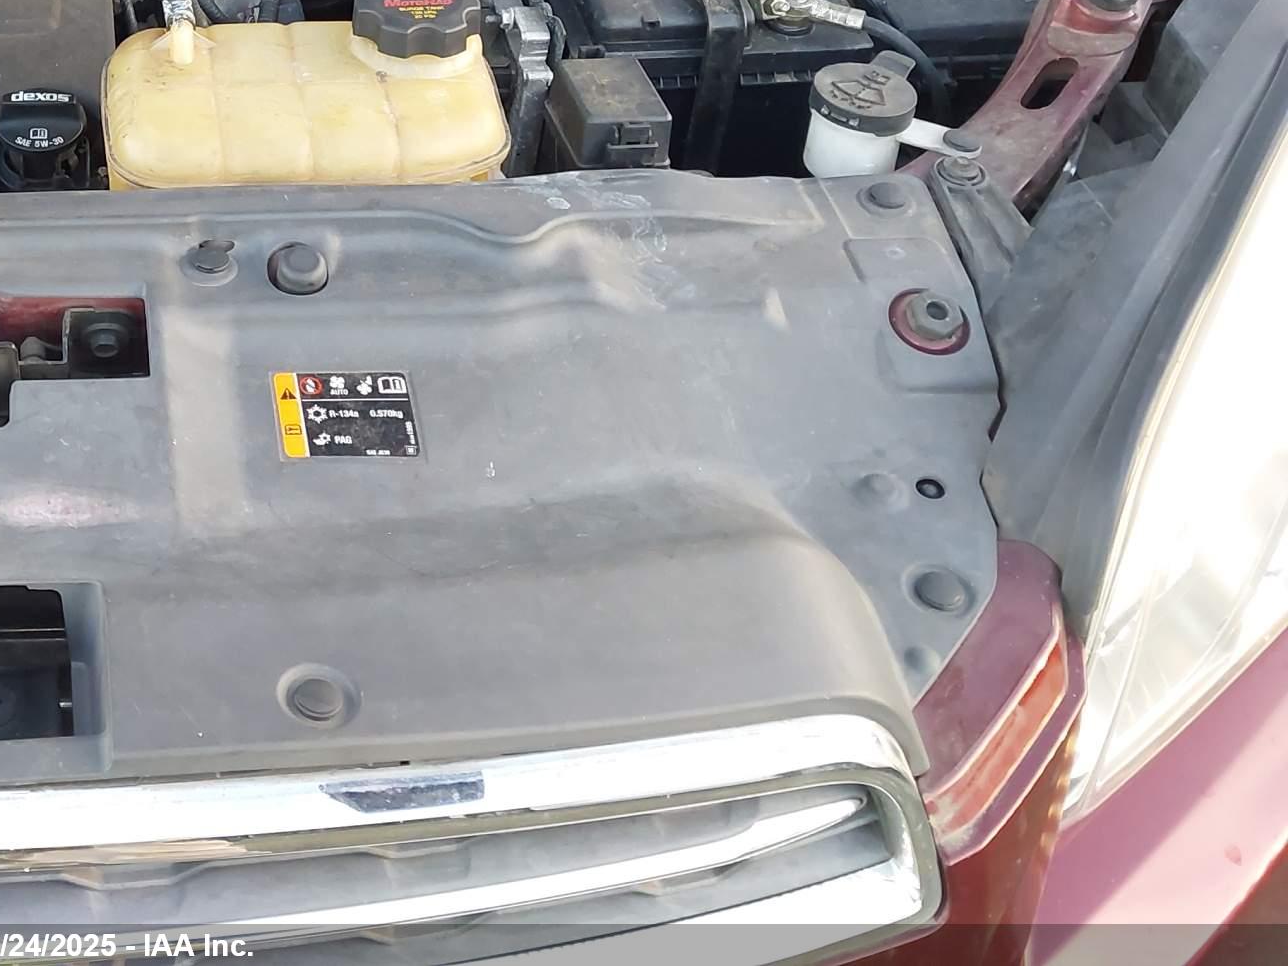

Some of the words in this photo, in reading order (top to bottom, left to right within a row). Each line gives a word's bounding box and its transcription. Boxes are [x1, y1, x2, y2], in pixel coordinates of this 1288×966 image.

[11, 91, 73, 103] dexos
[14, 136, 32, 148] SAE
[34, 136, 65, 148] 5W-30
[329, 410, 359, 418] R-134a
[334, 435, 353, 445] PAG
